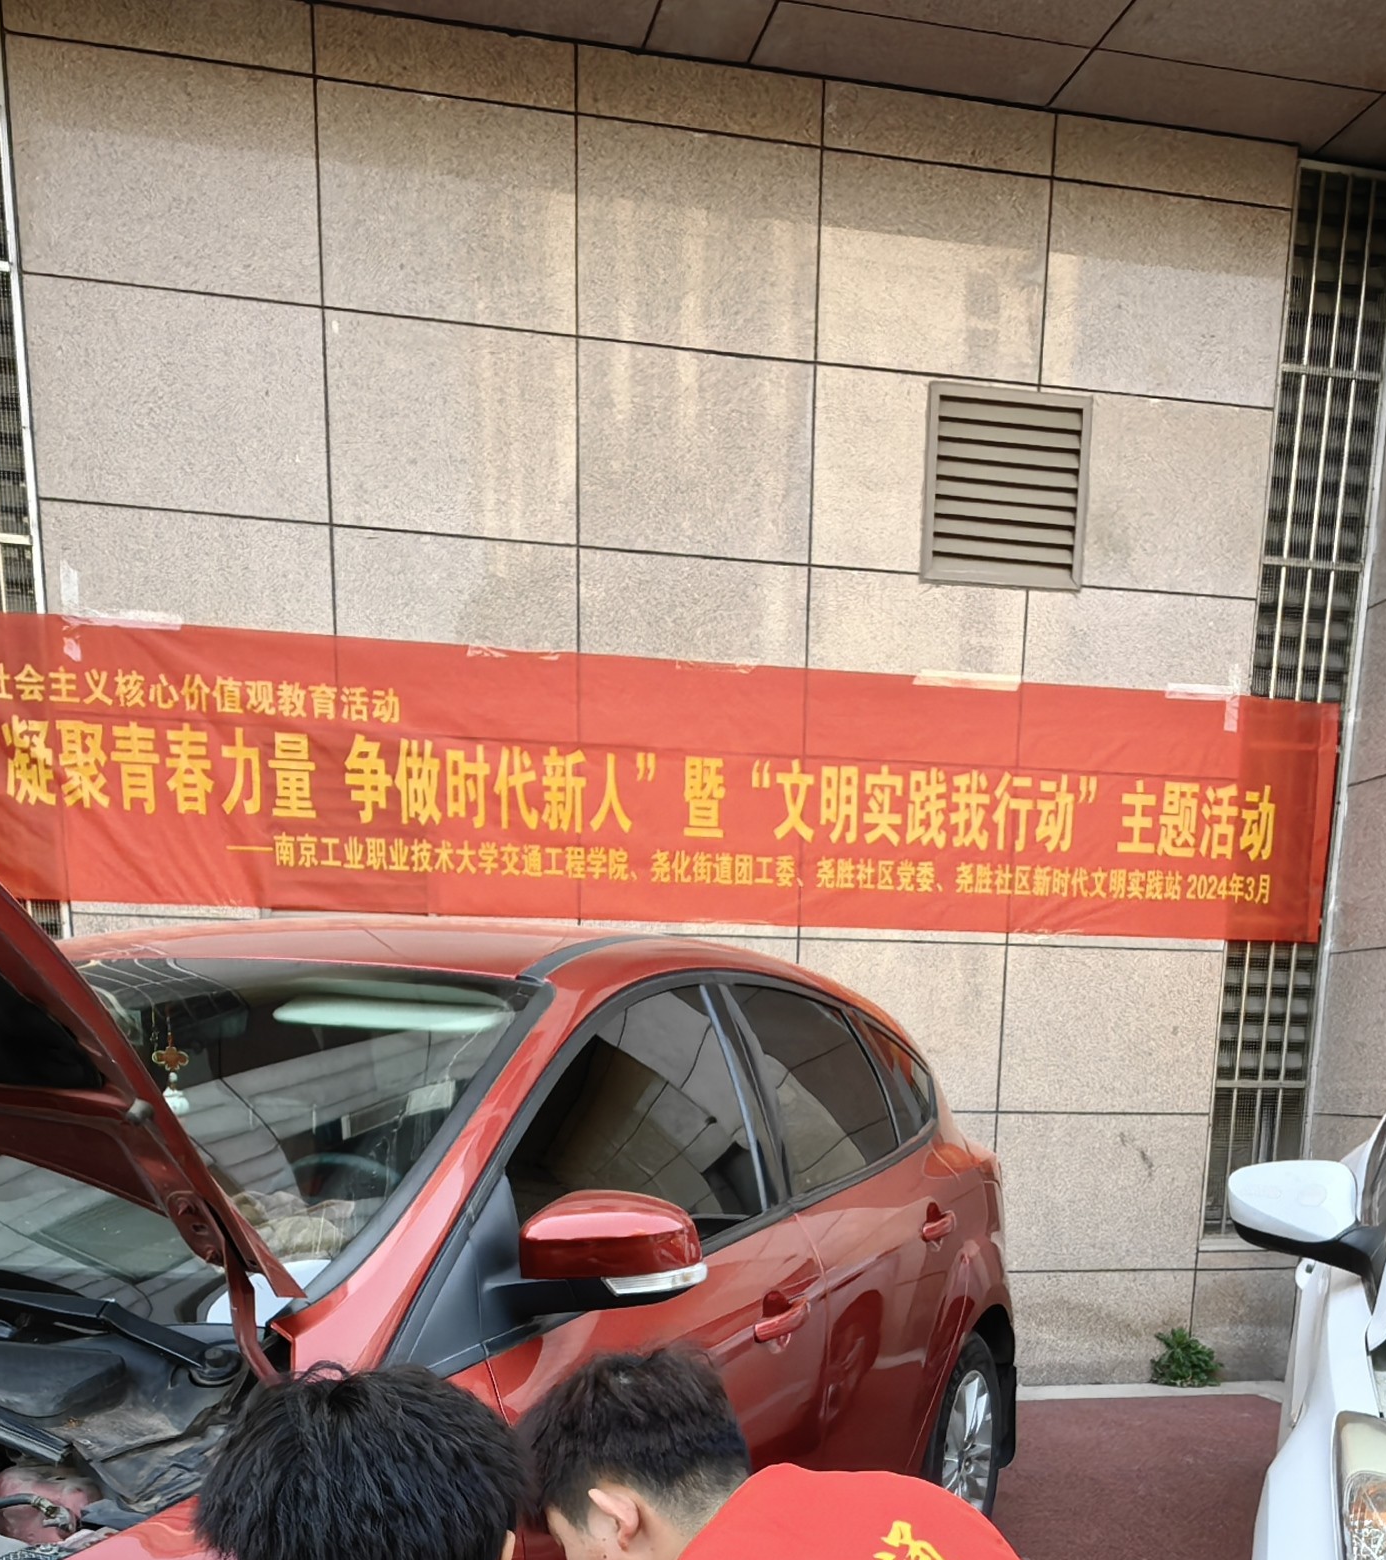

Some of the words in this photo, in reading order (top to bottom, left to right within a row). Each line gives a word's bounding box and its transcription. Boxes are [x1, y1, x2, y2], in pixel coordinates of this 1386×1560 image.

[343, 733, 656, 834] 争做时代新人”
[682, 755, 727, 839] 暨
[751, 758, 1098, 853] “文明实践我行动”
[1116, 779, 1276, 861] 主题活动
[1185, 872, 1272, 905] 2024年3月
